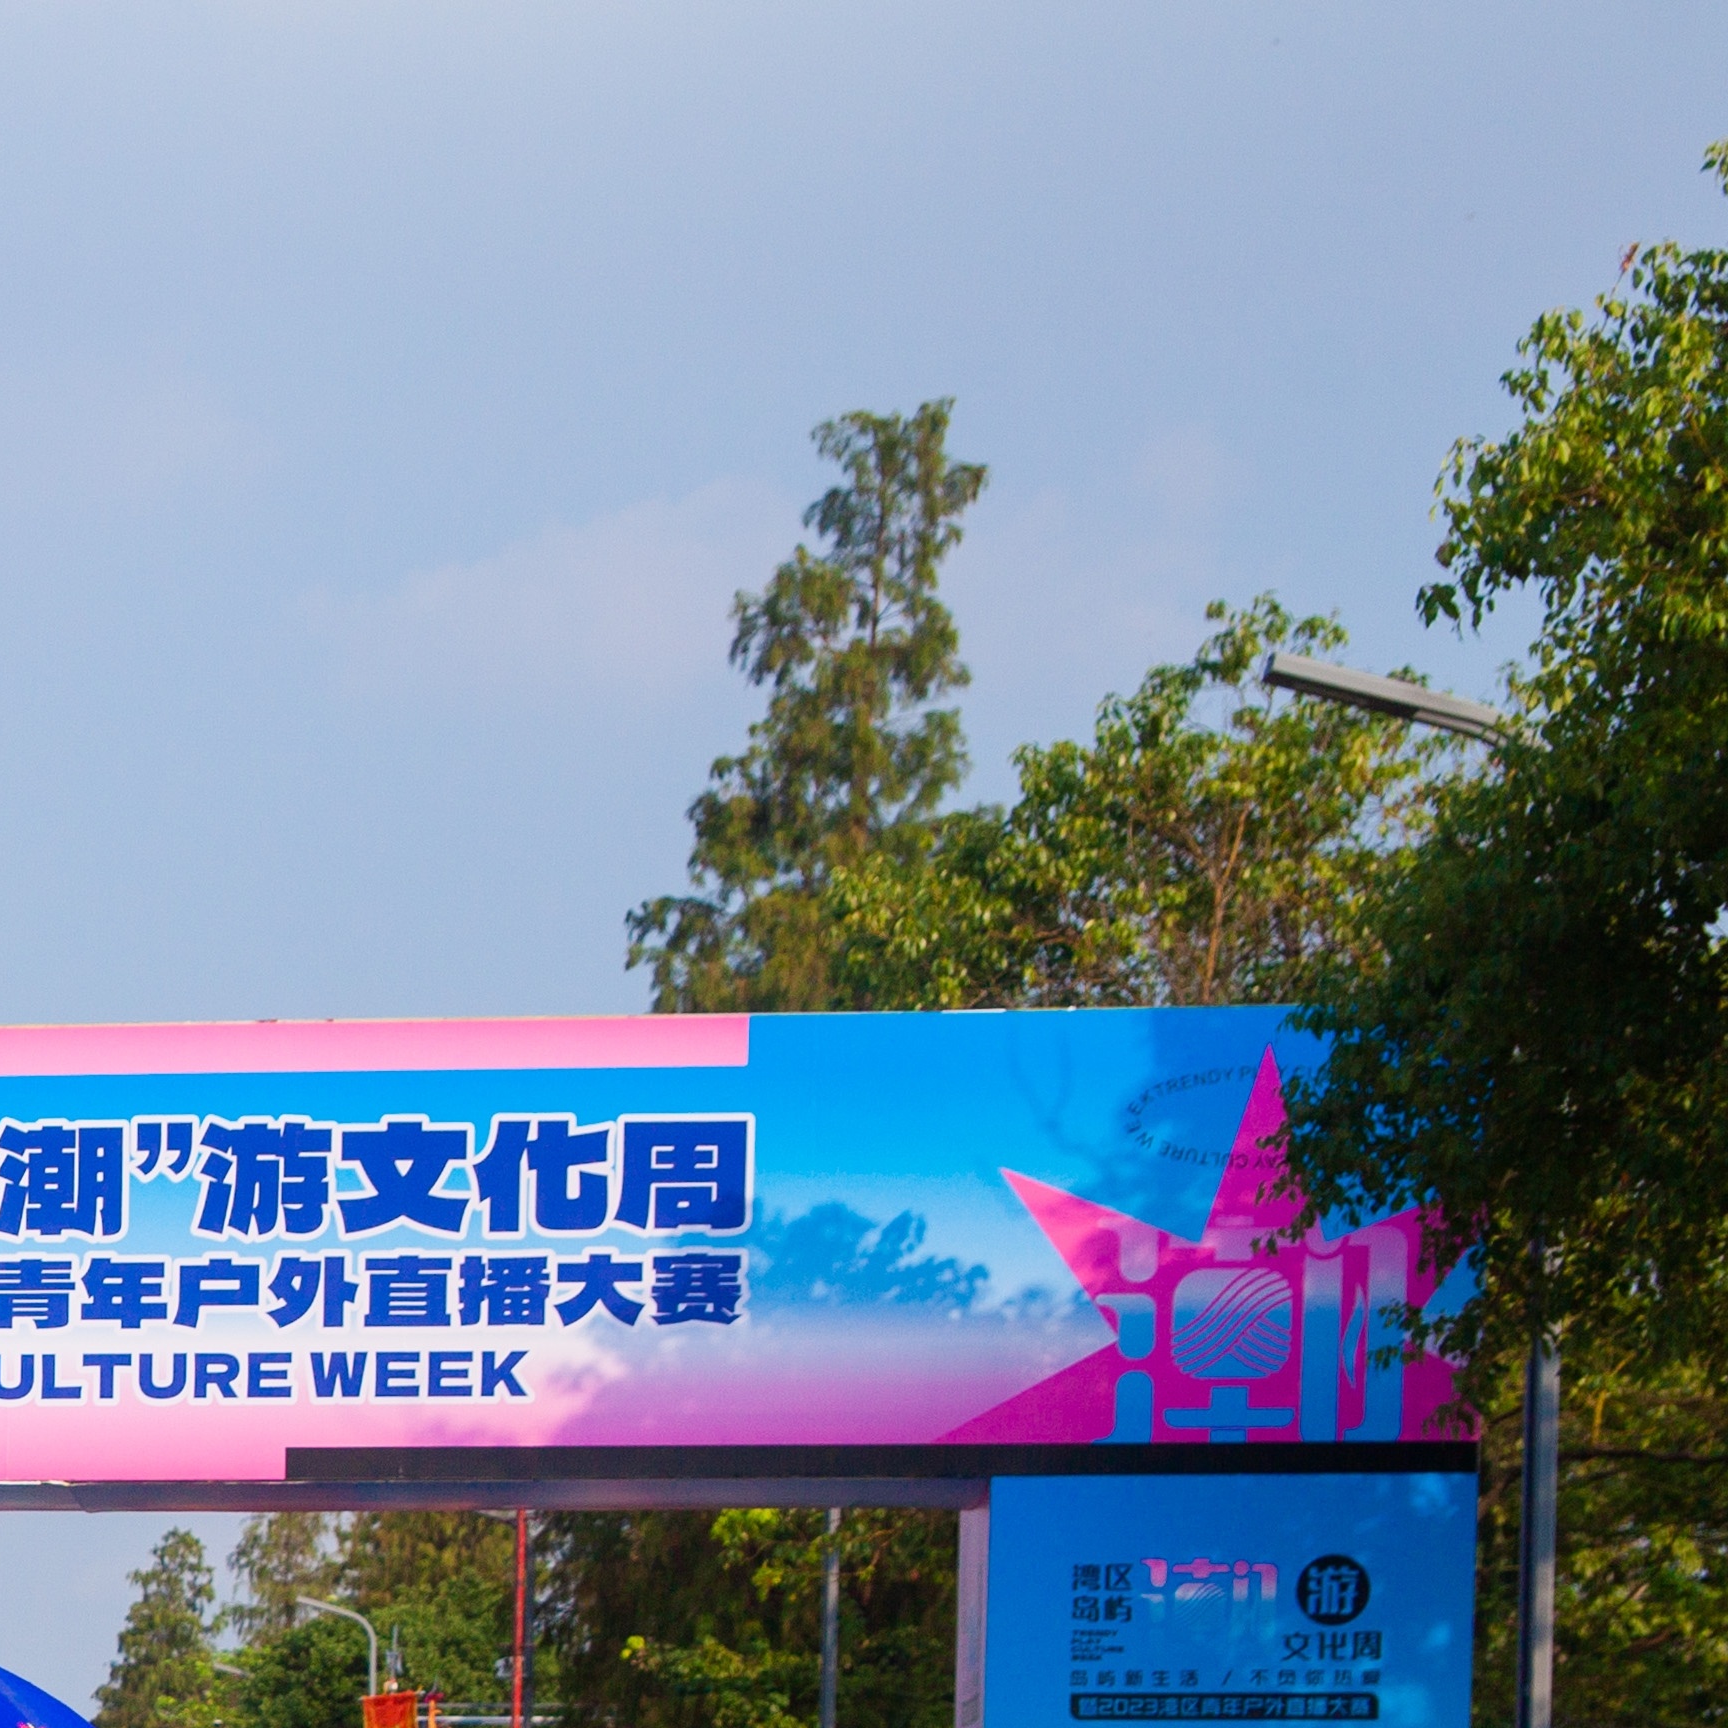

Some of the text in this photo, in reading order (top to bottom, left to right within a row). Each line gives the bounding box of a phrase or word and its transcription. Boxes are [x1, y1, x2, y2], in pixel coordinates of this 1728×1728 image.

[309, 1350, 530, 1399] WEEK
[1072, 1562, 1134, 1592] 湾区
[1306, 1564, 1360, 1616] 游
[1071, 1594, 1133, 1623] 岛屿
[1281, 1629, 1383, 1662] 文化周
